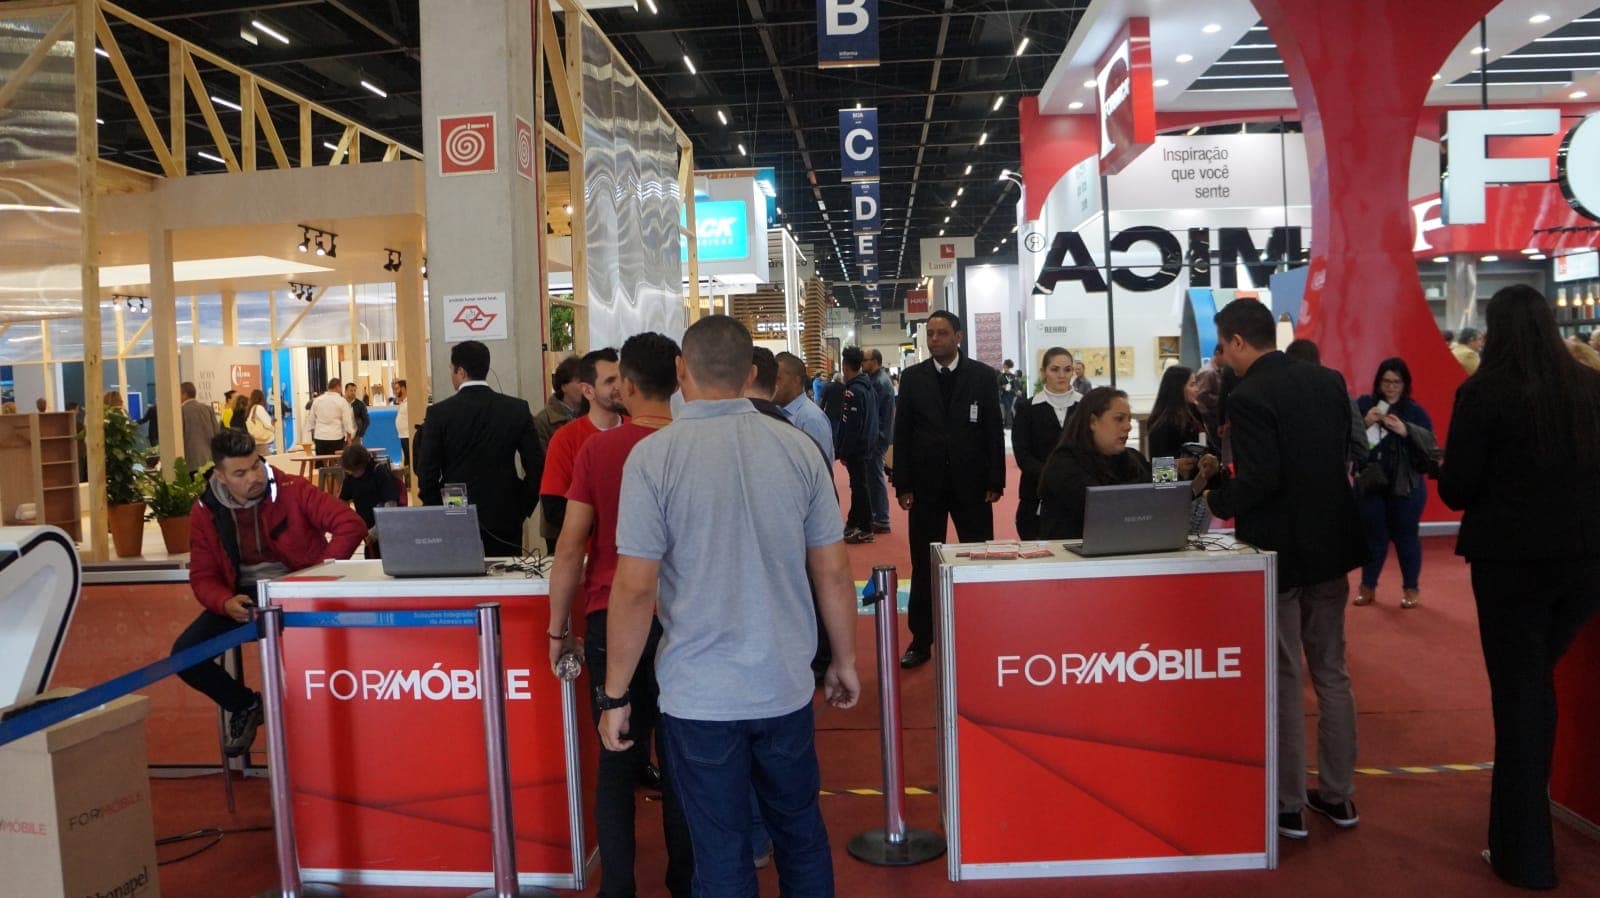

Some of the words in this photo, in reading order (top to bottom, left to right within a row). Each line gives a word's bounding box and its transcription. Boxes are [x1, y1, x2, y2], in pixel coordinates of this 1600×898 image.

[826, 0, 869, 35] B
[845, 128, 874, 160] C
[1163, 146, 1229, 164] Inspiração
[1171, 168, 1196, 183] que
[1199, 164, 1229, 179] você
[1195, 184, 1230, 199] sente
[855, 196, 877, 220] D
[859, 236, 874, 255] E
